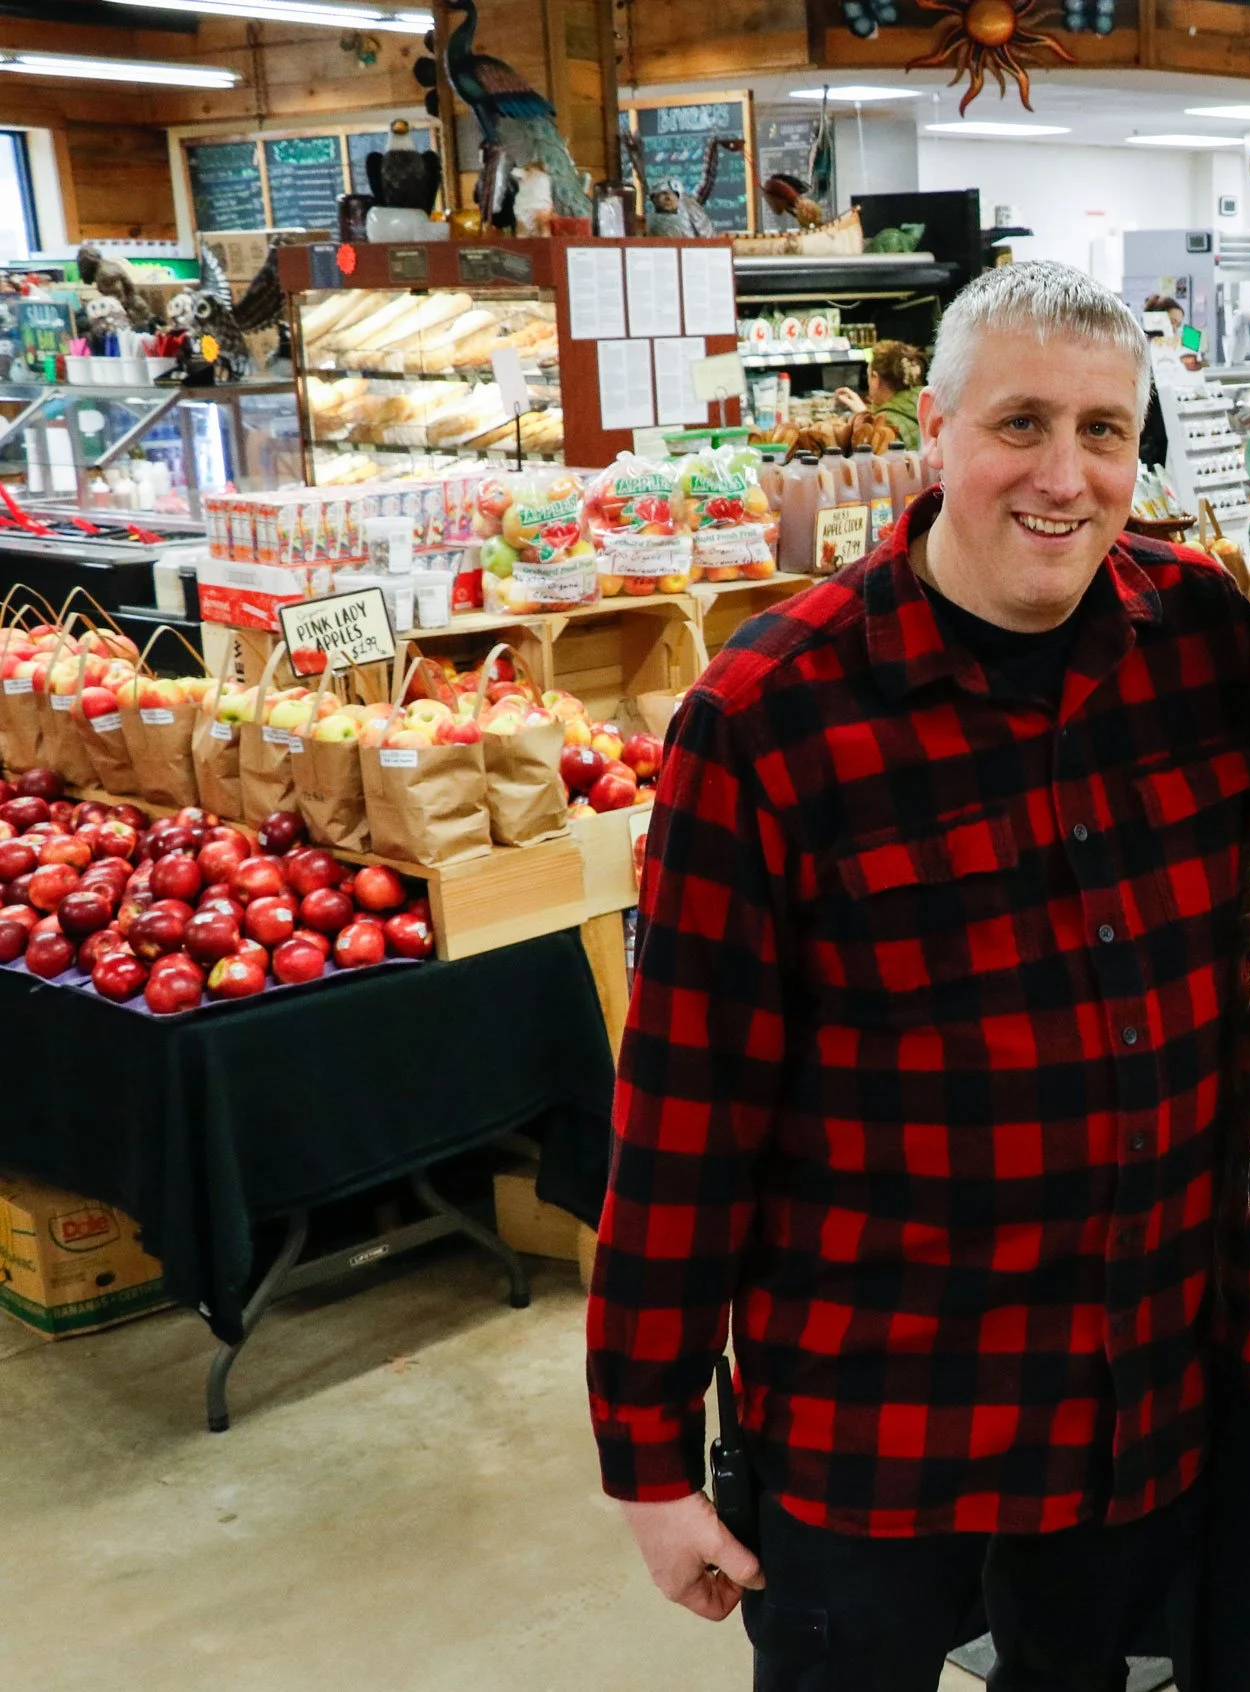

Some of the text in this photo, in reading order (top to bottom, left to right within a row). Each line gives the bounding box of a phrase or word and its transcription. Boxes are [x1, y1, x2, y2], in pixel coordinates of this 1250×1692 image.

[615, 474, 672, 495] APPLES
[520, 493, 579, 525] APPLES
[823, 521, 842, 537] APPLE
[296, 600, 367, 642] PINK LADY
[316, 624, 363, 653] APPLES
[61, 1215, 111, 1241] Dole
